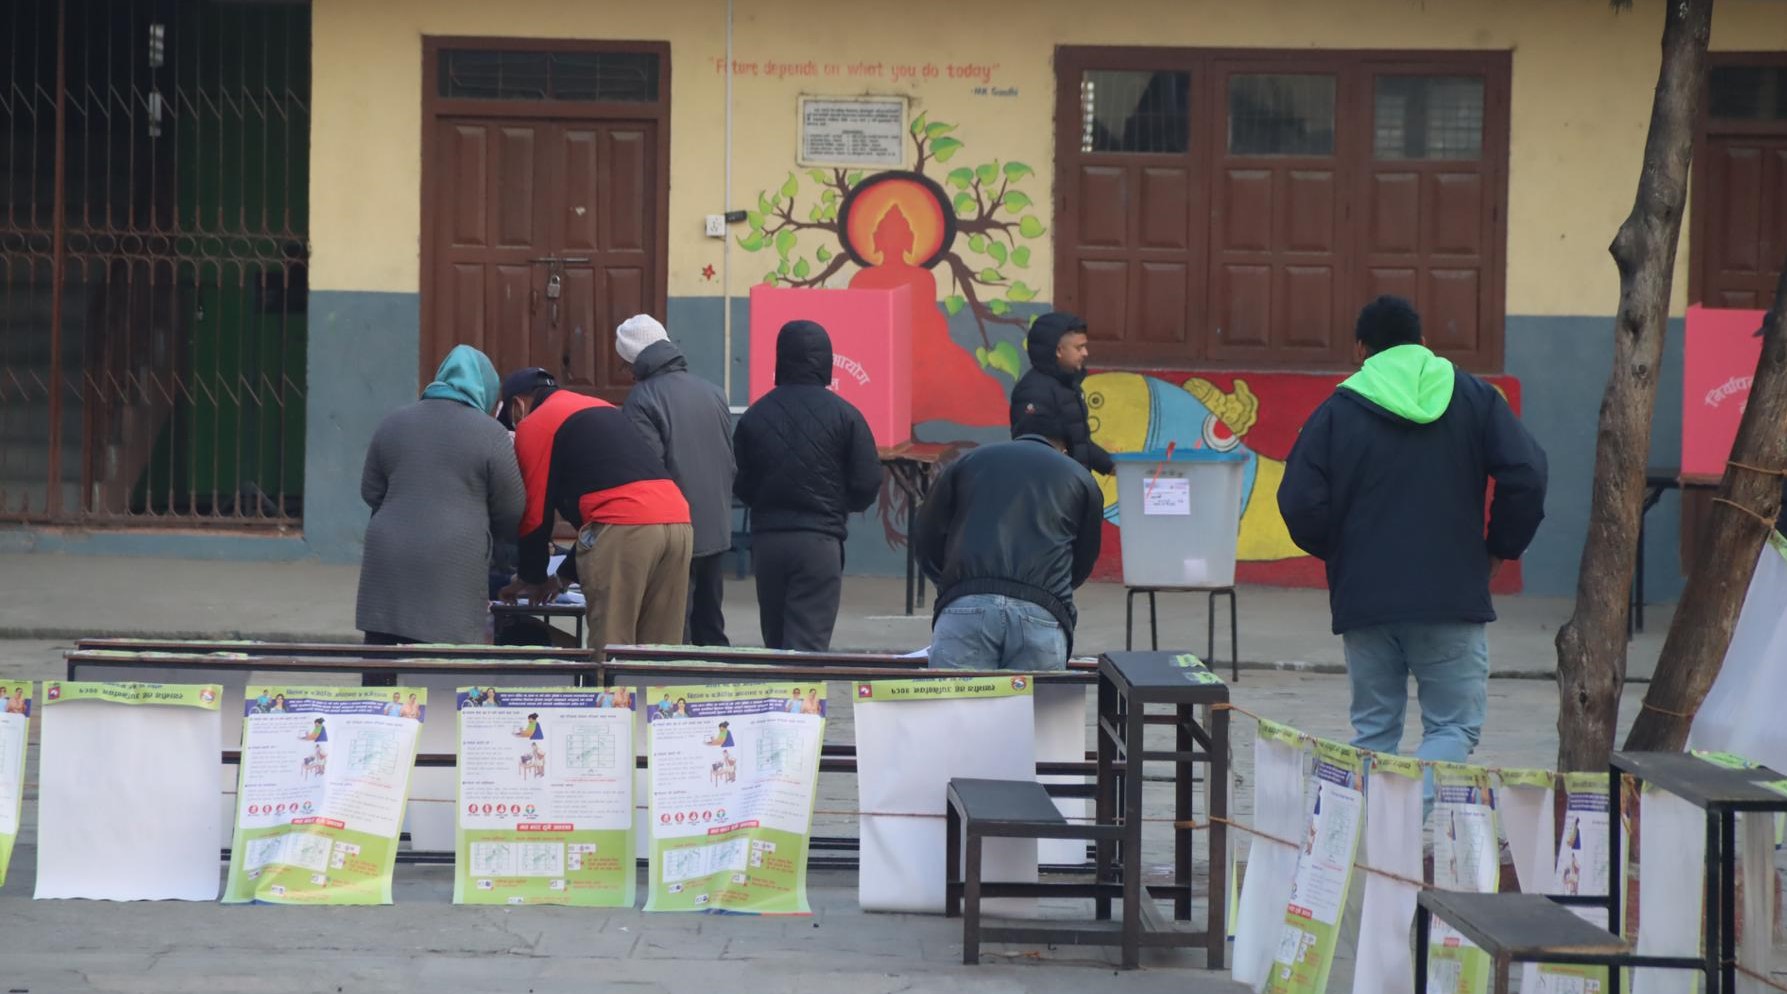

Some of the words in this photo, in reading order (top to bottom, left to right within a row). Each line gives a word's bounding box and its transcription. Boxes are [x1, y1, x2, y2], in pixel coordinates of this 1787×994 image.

[764, 59, 818, 81] depends
[824, 62, 840, 76] on
[847, 61, 883, 77] what
[892, 63, 916, 83] you
[922, 62, 939, 78] do
